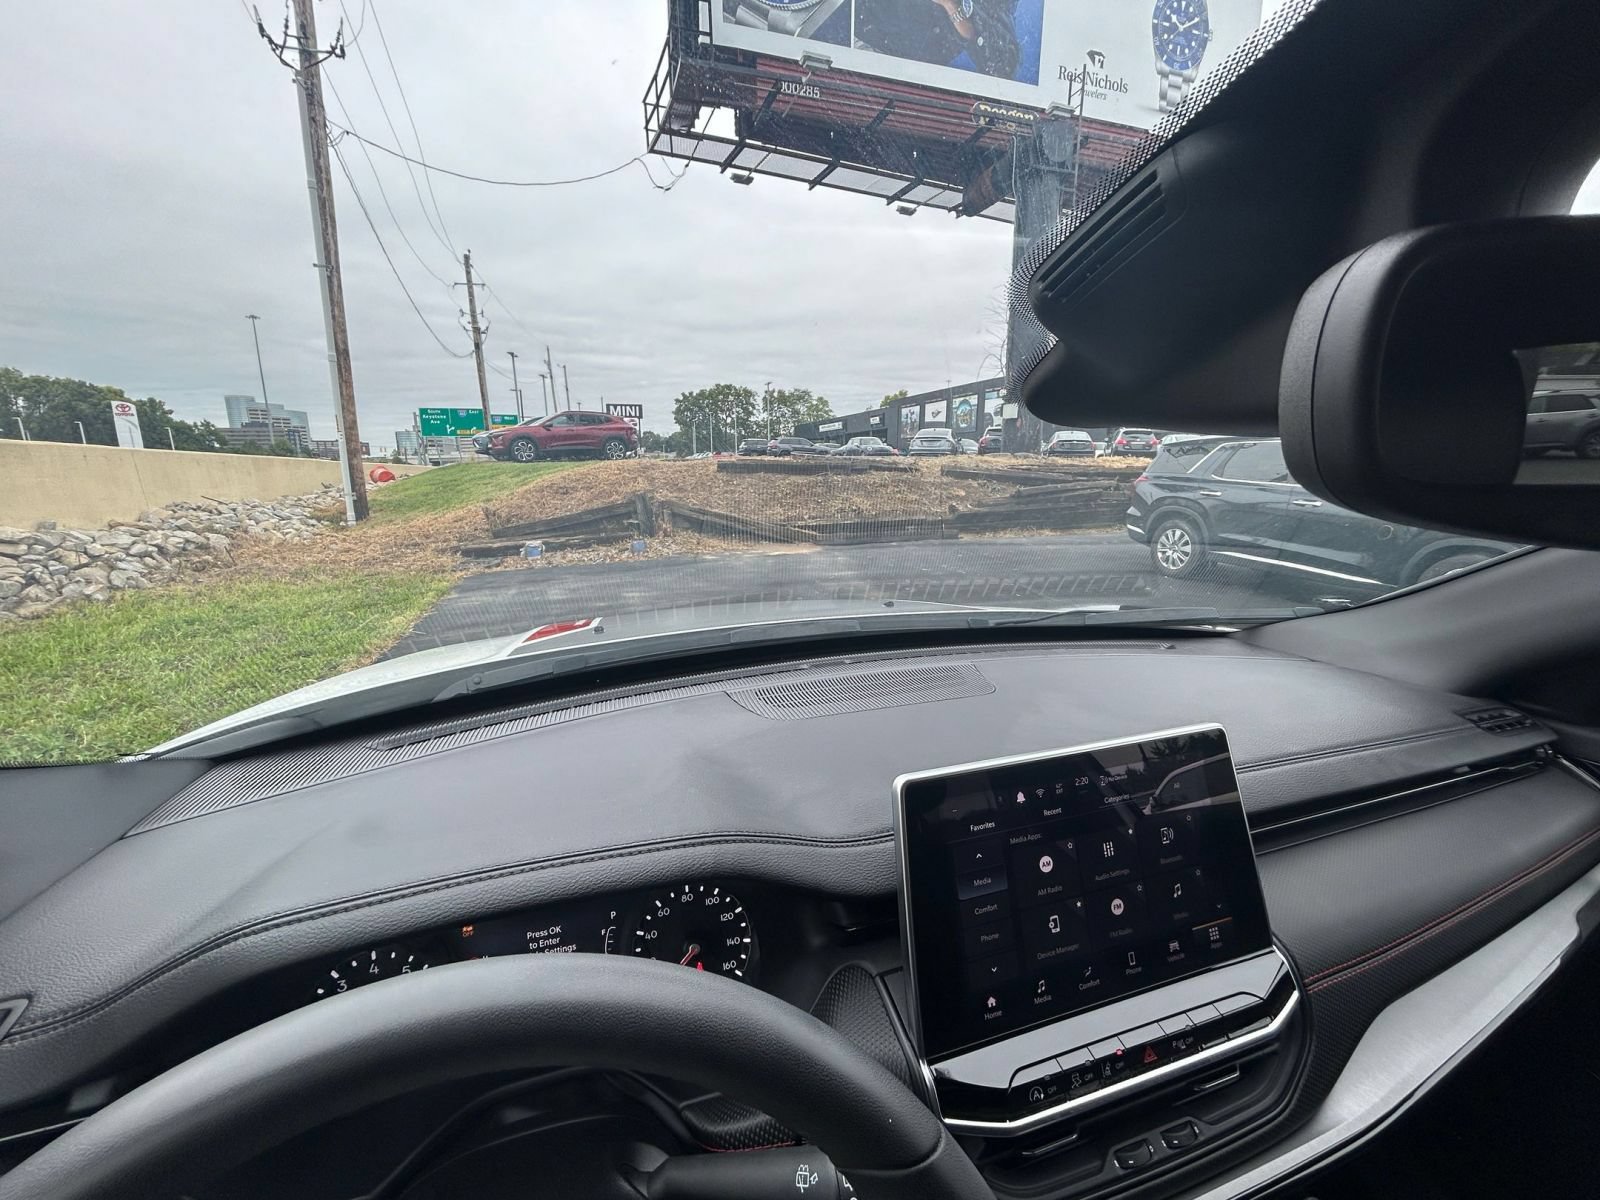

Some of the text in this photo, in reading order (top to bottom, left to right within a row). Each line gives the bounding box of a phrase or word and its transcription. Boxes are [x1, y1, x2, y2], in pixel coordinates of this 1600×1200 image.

[1058, 65, 1129, 93] Reis Nichols
[609, 405, 640, 417] MINI
[1075, 777, 1089, 786] 2:20
[1104, 794, 1130, 804] Categories
[1043, 807, 1062, 817] Recent
[970, 821, 996, 832] Favorites
[1009, 836, 1027, 845] Media
[1041, 860, 1051, 868] AM
[973, 877, 992, 887] Media
[1037, 885, 1063, 896] AM Radio
[681, 893, 694, 903] 80
[705, 896, 720, 906] 100
[657, 907, 670, 917] 60
[974, 904, 998, 915] Comfort
[610, 911, 617, 919] P
[720, 912, 734, 922] 120
[527, 925, 562, 939] Press OK
[644, 930, 658, 940] 40
[726, 937, 740, 946] 140
[980, 933, 1000, 943] Phone
[529, 937, 560, 950] to Enter
[369, 963, 379, 974] 4
[402, 965, 411, 974] 5
[722, 960, 737, 970] 160
[1125, 965, 1142, 975] Phone
[337, 979, 347, 992] 3
[1078, 979, 1100, 990] Comfort
[1034, 995, 1052, 1004] Media
[984, 1010, 1003, 1020] Home
